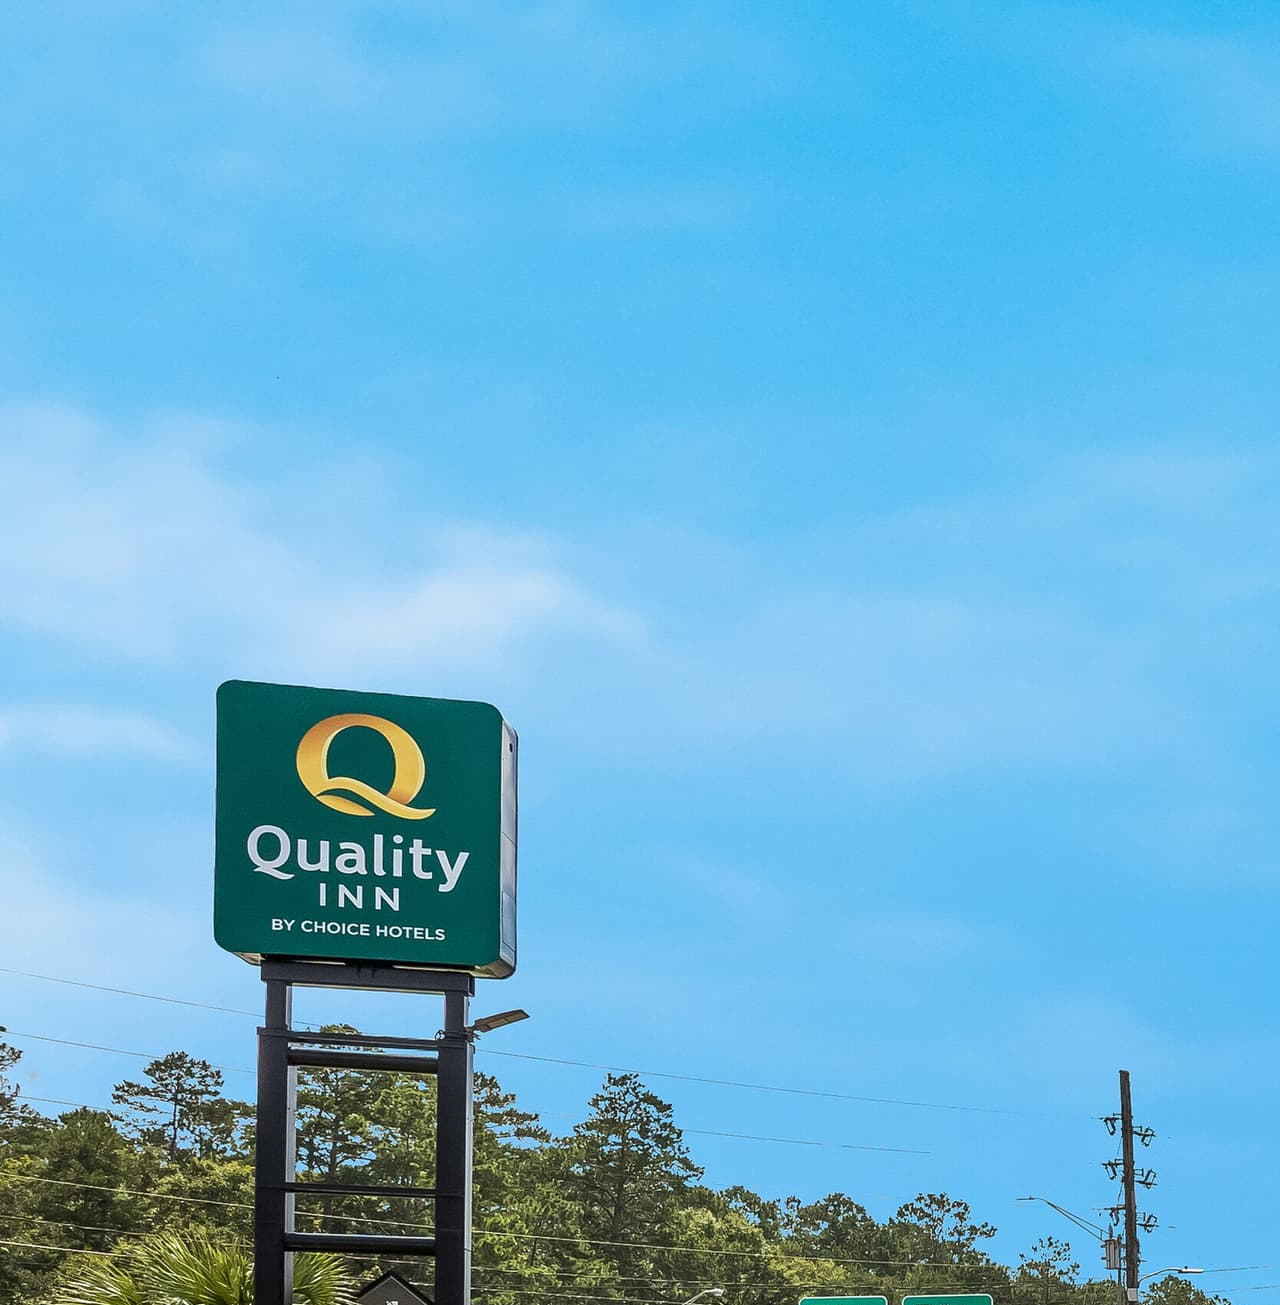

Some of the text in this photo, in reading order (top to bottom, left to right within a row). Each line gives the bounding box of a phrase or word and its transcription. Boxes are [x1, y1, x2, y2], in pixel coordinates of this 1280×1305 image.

[247, 824, 470, 892] Quality
[319, 883, 400, 911] INN
[271, 918, 445, 941] BY CHOICE HOTELS
